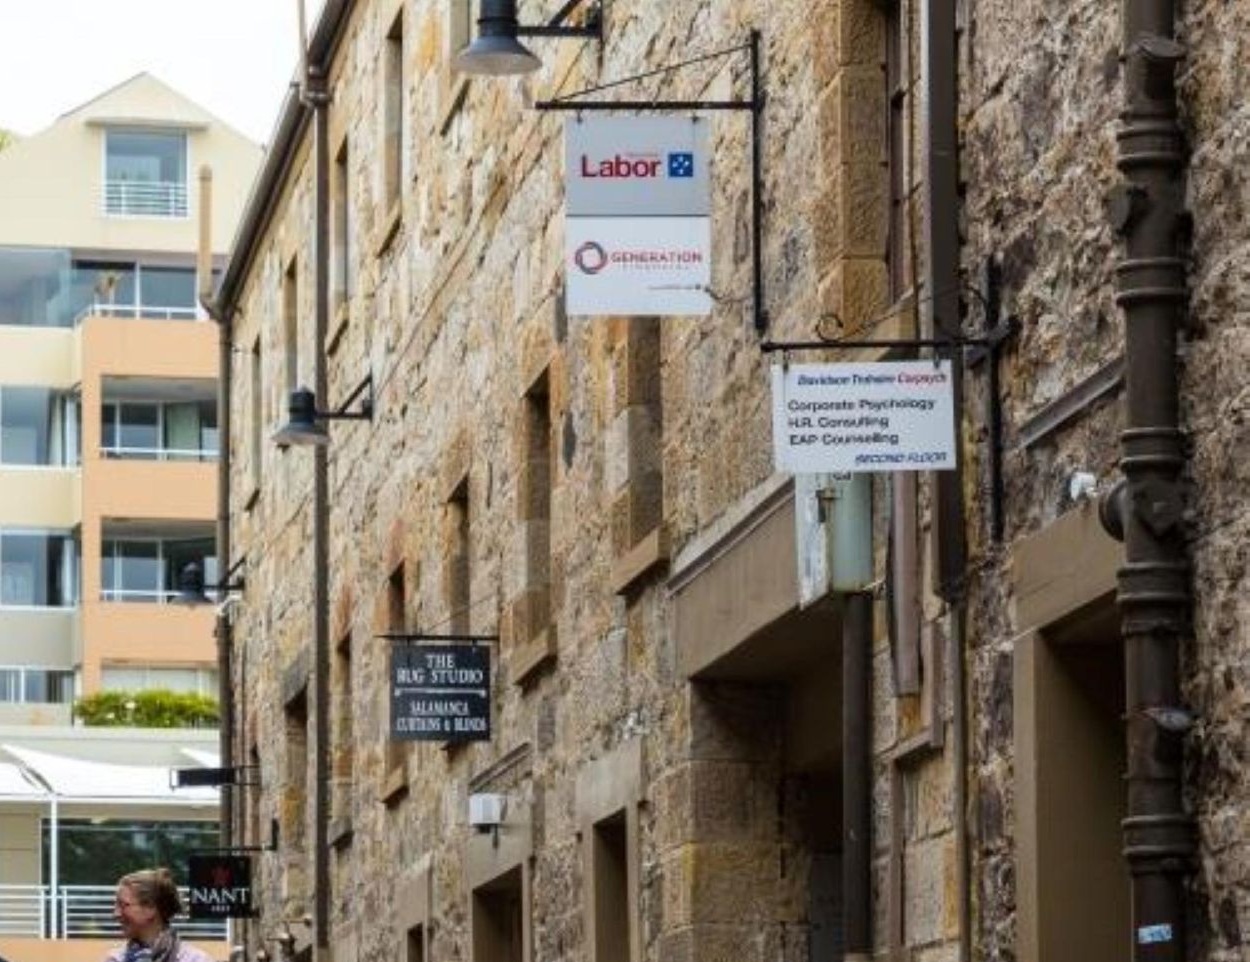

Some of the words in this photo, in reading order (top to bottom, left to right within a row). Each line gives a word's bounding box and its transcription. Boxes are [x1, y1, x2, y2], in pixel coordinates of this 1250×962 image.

[581, 154, 661, 178] Labor
[611, 251, 702, 263] GENERATION
[788, 400, 855, 413] Corporate
[859, 398, 935, 411] Psychology
[818, 416, 889, 429] Consulting
[790, 434, 818, 446] EAP
[822, 432, 899, 446] Counselling
[425, 653, 455, 669] THE
[396, 668, 426, 684] RUG
[431, 669, 484, 684] STUDIO
[191, 887, 250, 904] NANT
